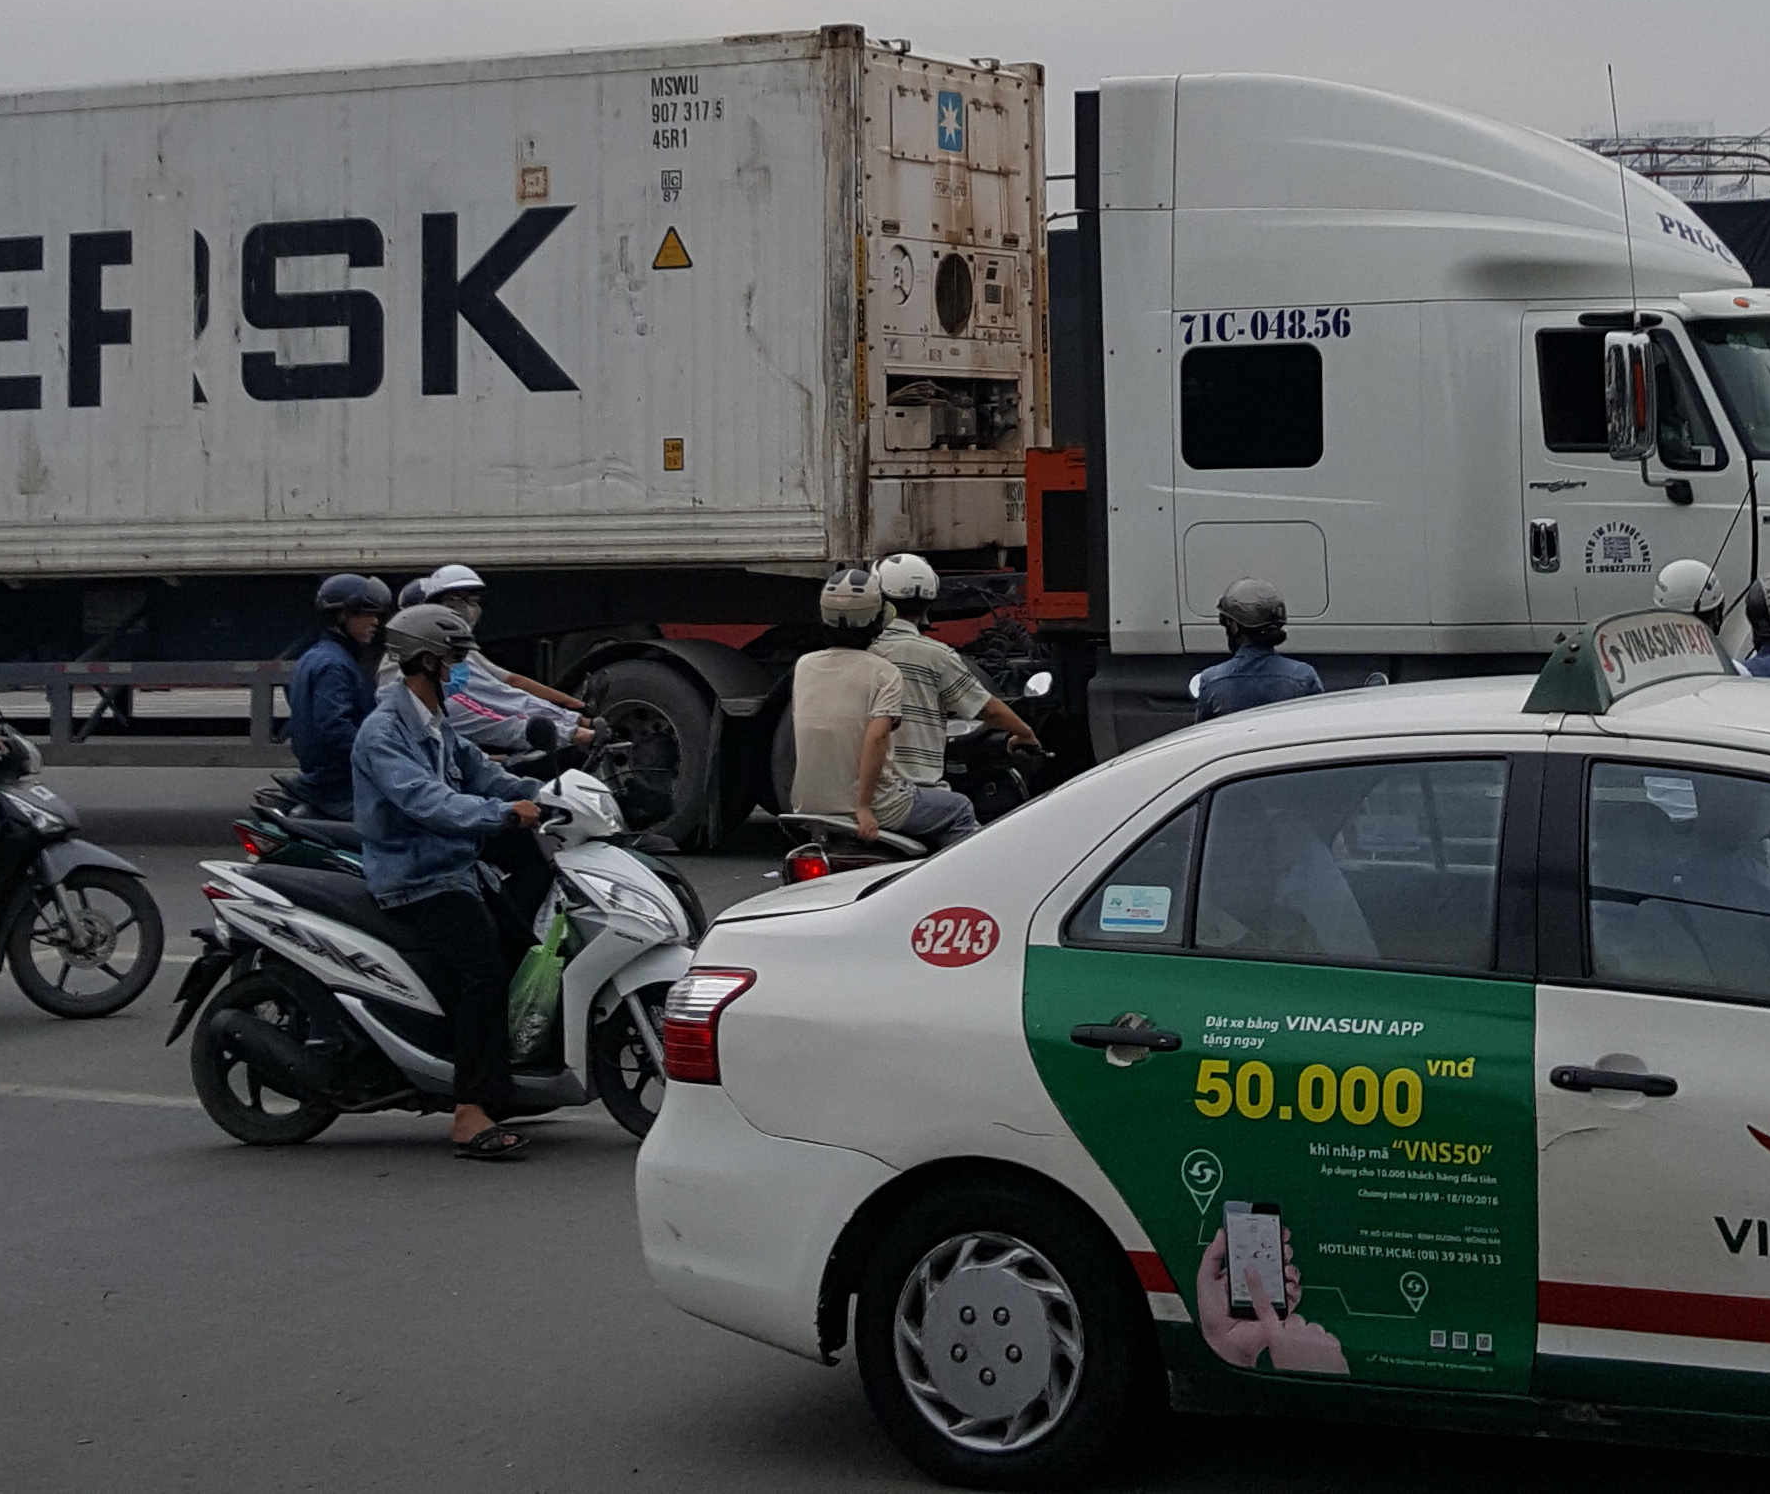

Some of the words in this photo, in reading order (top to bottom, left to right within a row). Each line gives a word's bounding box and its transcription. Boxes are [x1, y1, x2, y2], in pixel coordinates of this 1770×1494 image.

[651, 75, 698, 97] MSWU
[652, 102, 677, 123] 907
[684, 100, 709, 121] 317
[715, 100, 722, 119] 5
[652, 127, 687, 149] 45R1
[663, 190, 679, 203] 87
[1179, 306, 1351, 346] 71C-048.56
[914, 917, 993, 955] 3243
[1205, 1015, 1228, 1030] Đặt
[1230, 1018, 1244, 1030] xe
[1247, 1017, 1279, 1032] bằng
[1285, 1015, 1384, 1035] VINASUN
[1387, 1020, 1425, 1037] APP
[1202, 1033, 1231, 1049] tặng
[1233, 1036, 1265, 1049] ngay
[1194, 1058, 1424, 1128] 50.000
[1426, 1056, 1476, 1079] vnđ
[1309, 1142, 1330, 1156] khi
[1332, 1145, 1367, 1161] nhập
[1369, 1146, 1390, 1160] mã
[1359, 1166, 1375, 1177] cho
[1377, 1168, 1406, 1179] 10.000
[1318, 1243, 1367, 1257] HOTLINE
[1368, 1245, 1384, 1257] TP.
[1385, 1247, 1416, 1260] HCM:
[1417, 1249, 1440, 1263] (08)
[1441, 1250, 1456, 1262] 39
[1481, 1252, 1502, 1265] 133
